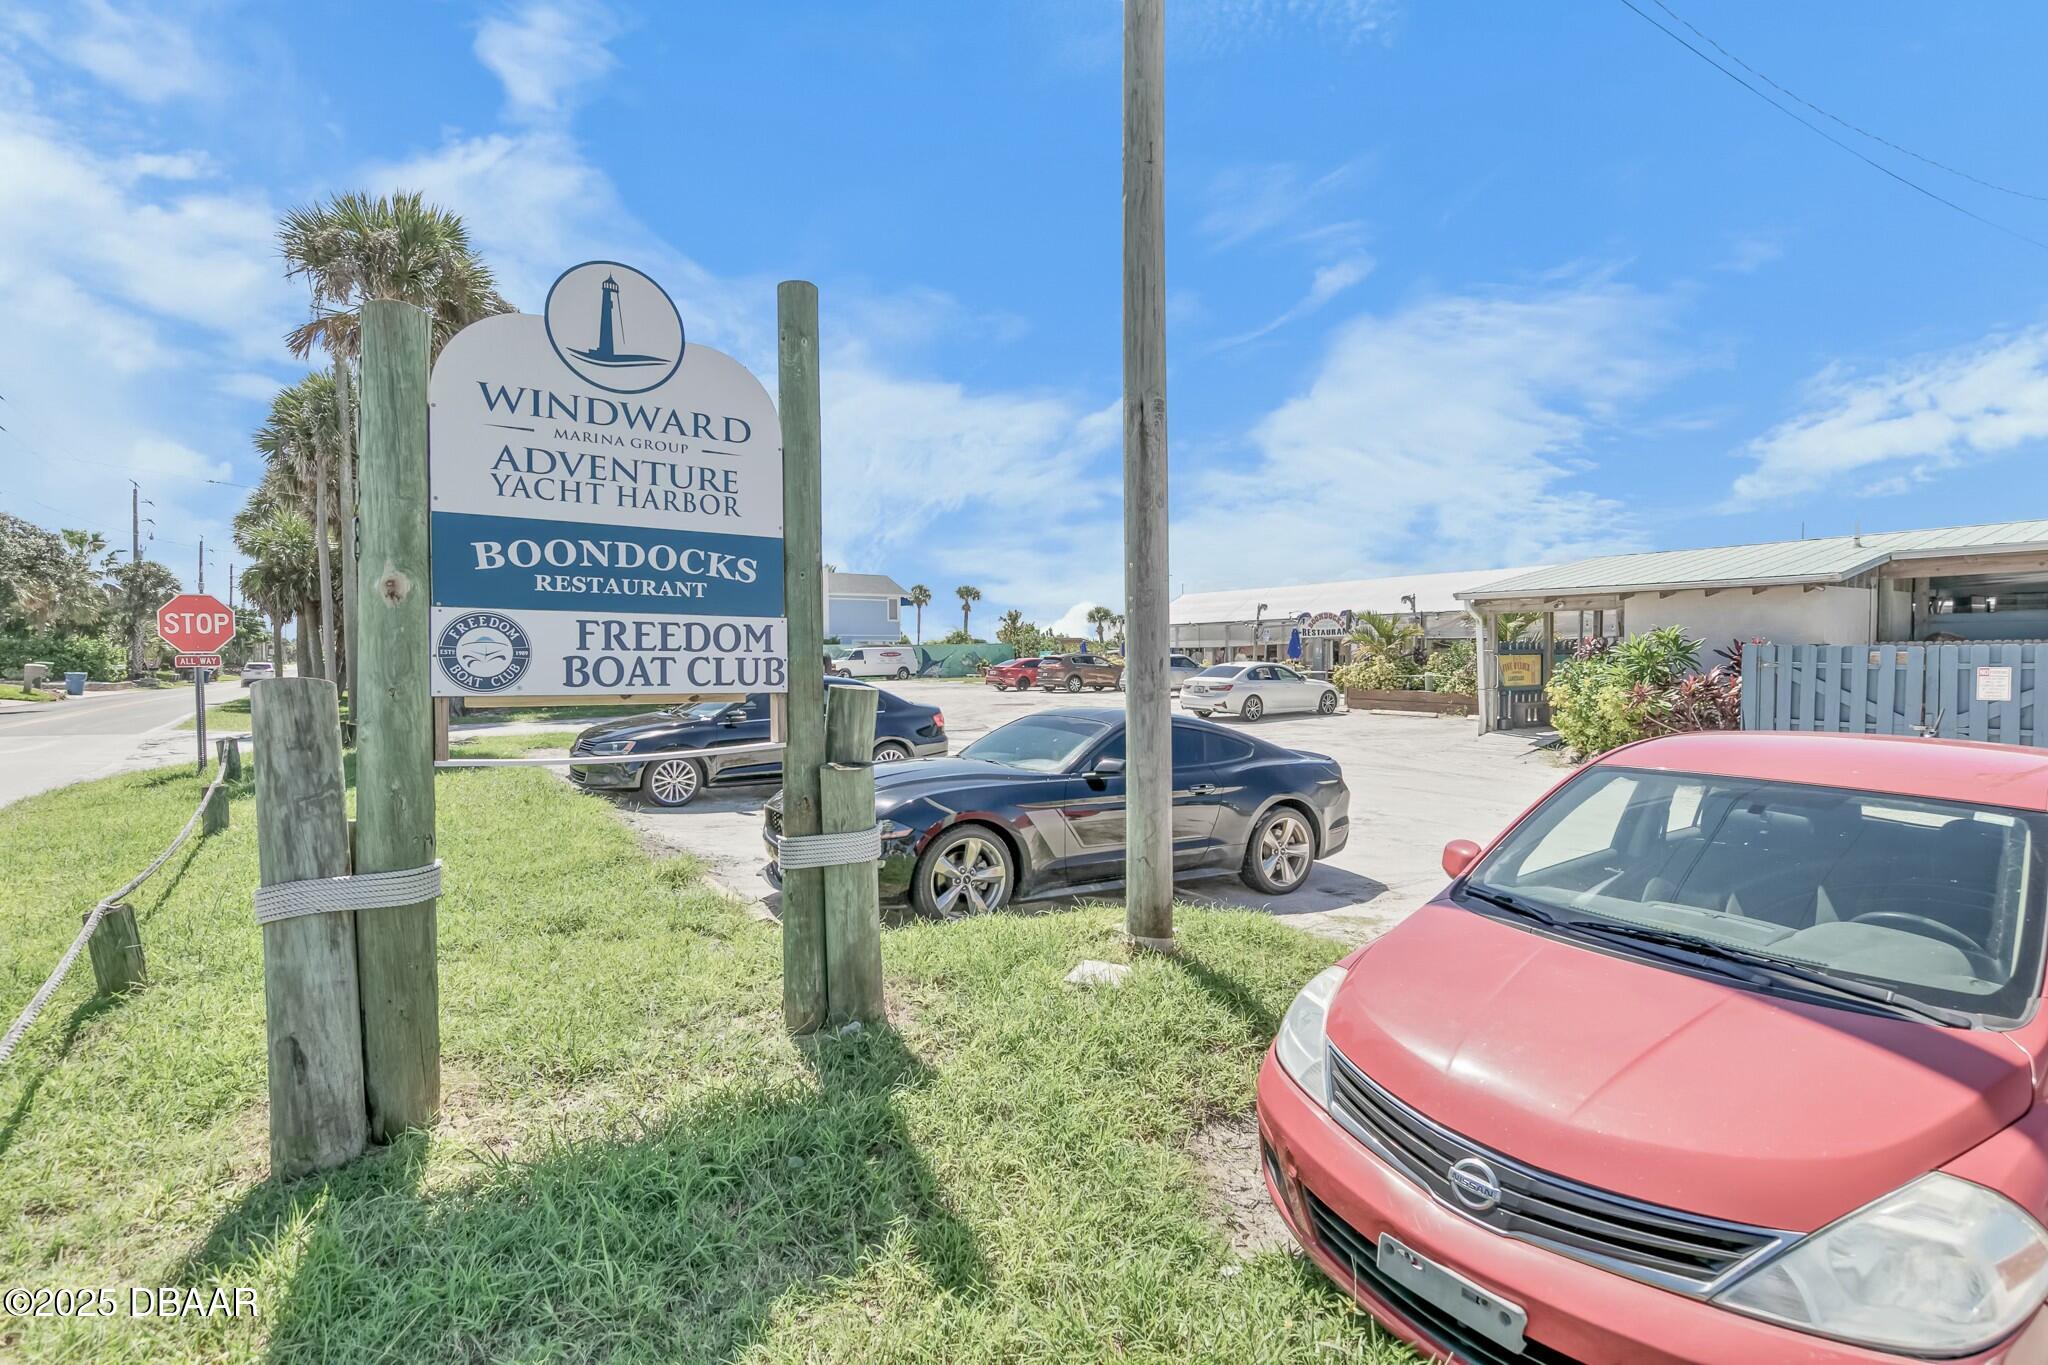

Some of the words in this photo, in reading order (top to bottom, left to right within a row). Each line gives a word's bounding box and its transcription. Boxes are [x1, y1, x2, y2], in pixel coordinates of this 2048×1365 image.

[476, 381, 751, 444] WINDWARD
[553, 427, 625, 447] MARINA
[630, 438, 689, 455] GROUP
[490, 445, 739, 494] ADVENTURE
[489, 473, 605, 505] YACHT
[617, 485, 742, 518] HARBOR
[470, 539, 758, 584] BOONDOCKS
[534, 574, 707, 599] RESTAURANT
[164, 613, 229, 634] STOP
[448, 616, 520, 640] FREEDOM
[575, 619, 774, 653] FREEDOM
[1302, 628, 1347, 636] RESTAURAN
[180, 657, 196, 665] ALL
[200, 657, 217, 665] WAY
[563, 655, 677, 687] BOAT
[687, 656, 785, 687] CLUB
[450, 664, 483, 687] BOAT
[491, 663, 520, 687] CLUB
[1452, 1172, 1494, 1197] NISSAN
